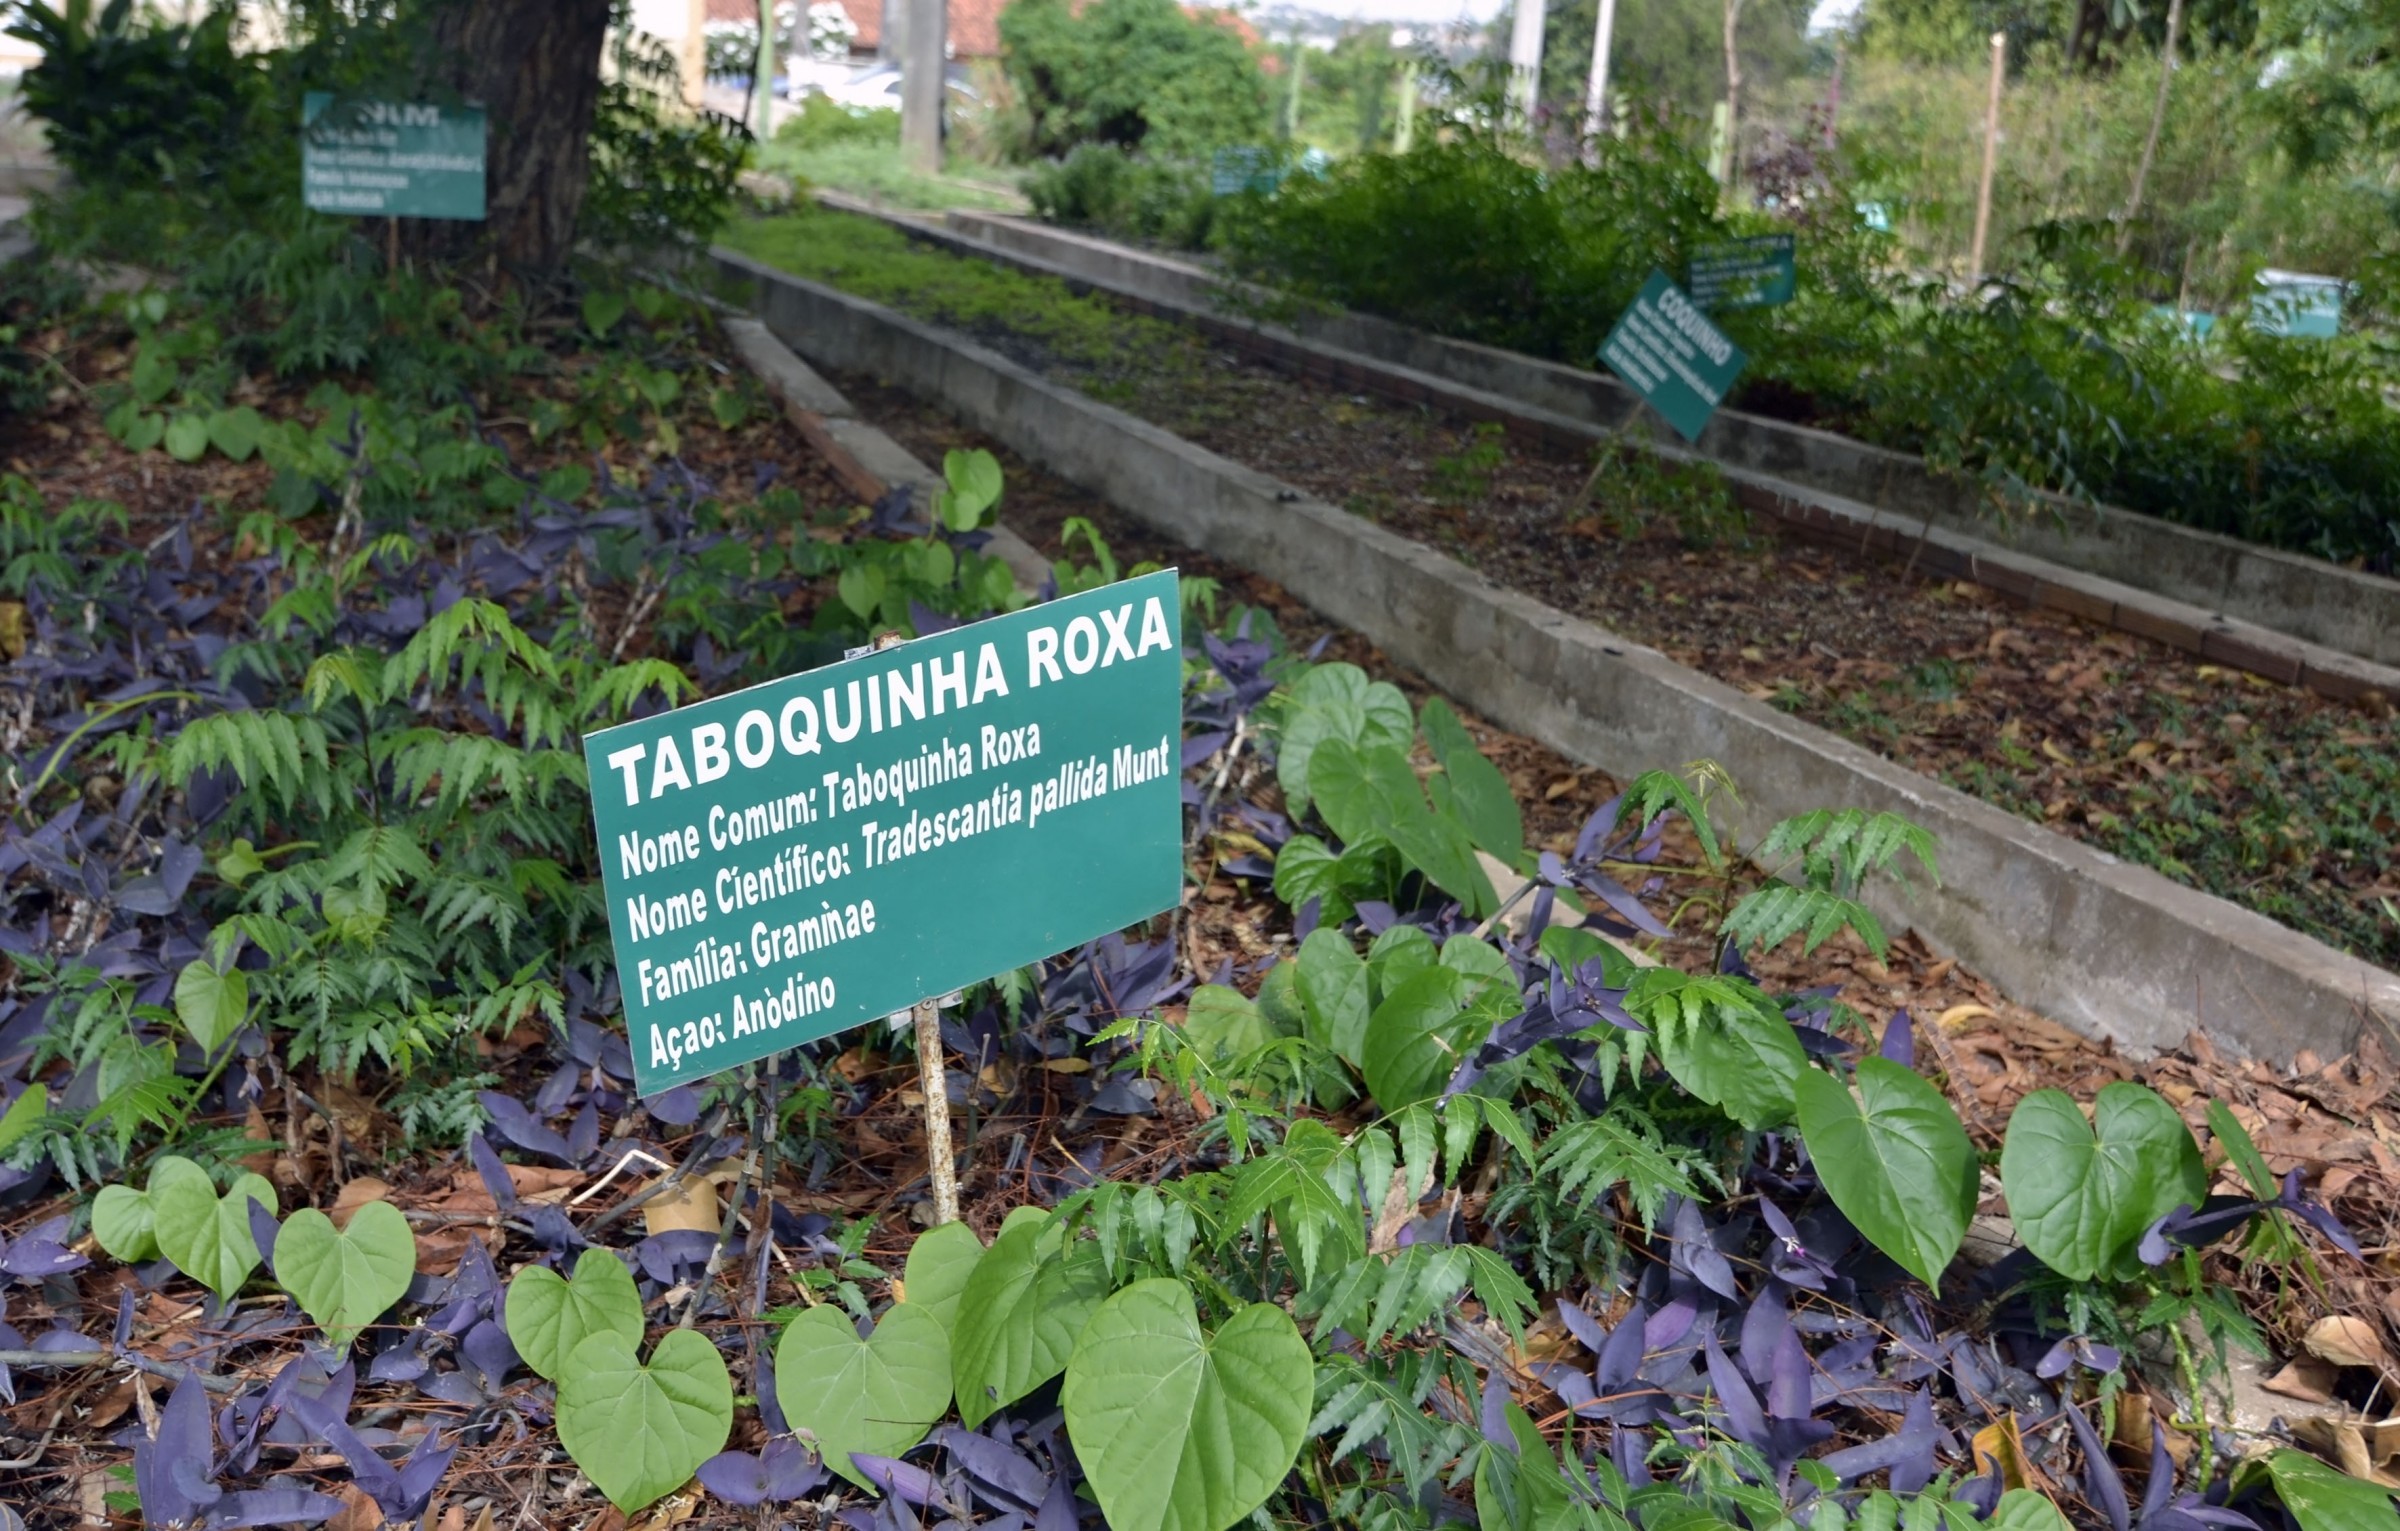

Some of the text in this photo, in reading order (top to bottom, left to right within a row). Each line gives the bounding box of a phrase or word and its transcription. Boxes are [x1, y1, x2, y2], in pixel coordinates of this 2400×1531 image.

[1657, 286, 1732, 367] COQUINHO
[607, 596, 1173, 807] TABOQUINHA ROXA
[618, 723, 1041, 880] Nome Comum: Taboquinha Roxa
[627, 888, 708, 943] Nome
[862, 782, 1022, 869] Tradescantia
[1029, 755, 1108, 829] pallida
[1112, 735, 1169, 791] Munt
[638, 936, 748, 1007] Família:
